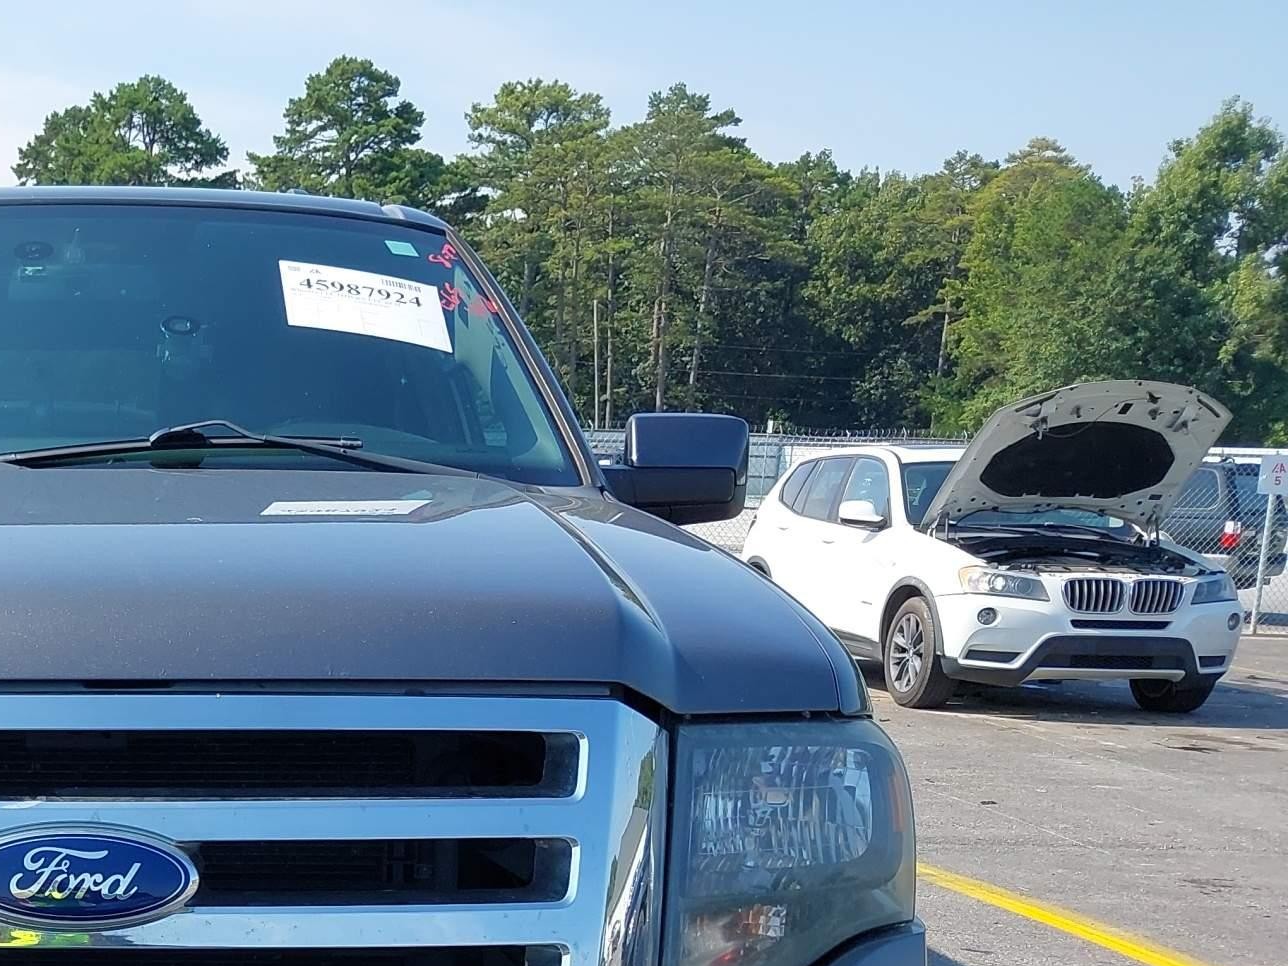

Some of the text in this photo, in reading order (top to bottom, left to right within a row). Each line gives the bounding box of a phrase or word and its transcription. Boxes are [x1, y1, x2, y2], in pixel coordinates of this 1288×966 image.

[299, 278, 423, 307] 45987924
[1274, 476, 1281, 486] 5
[9, 846, 142, 901] Ford
